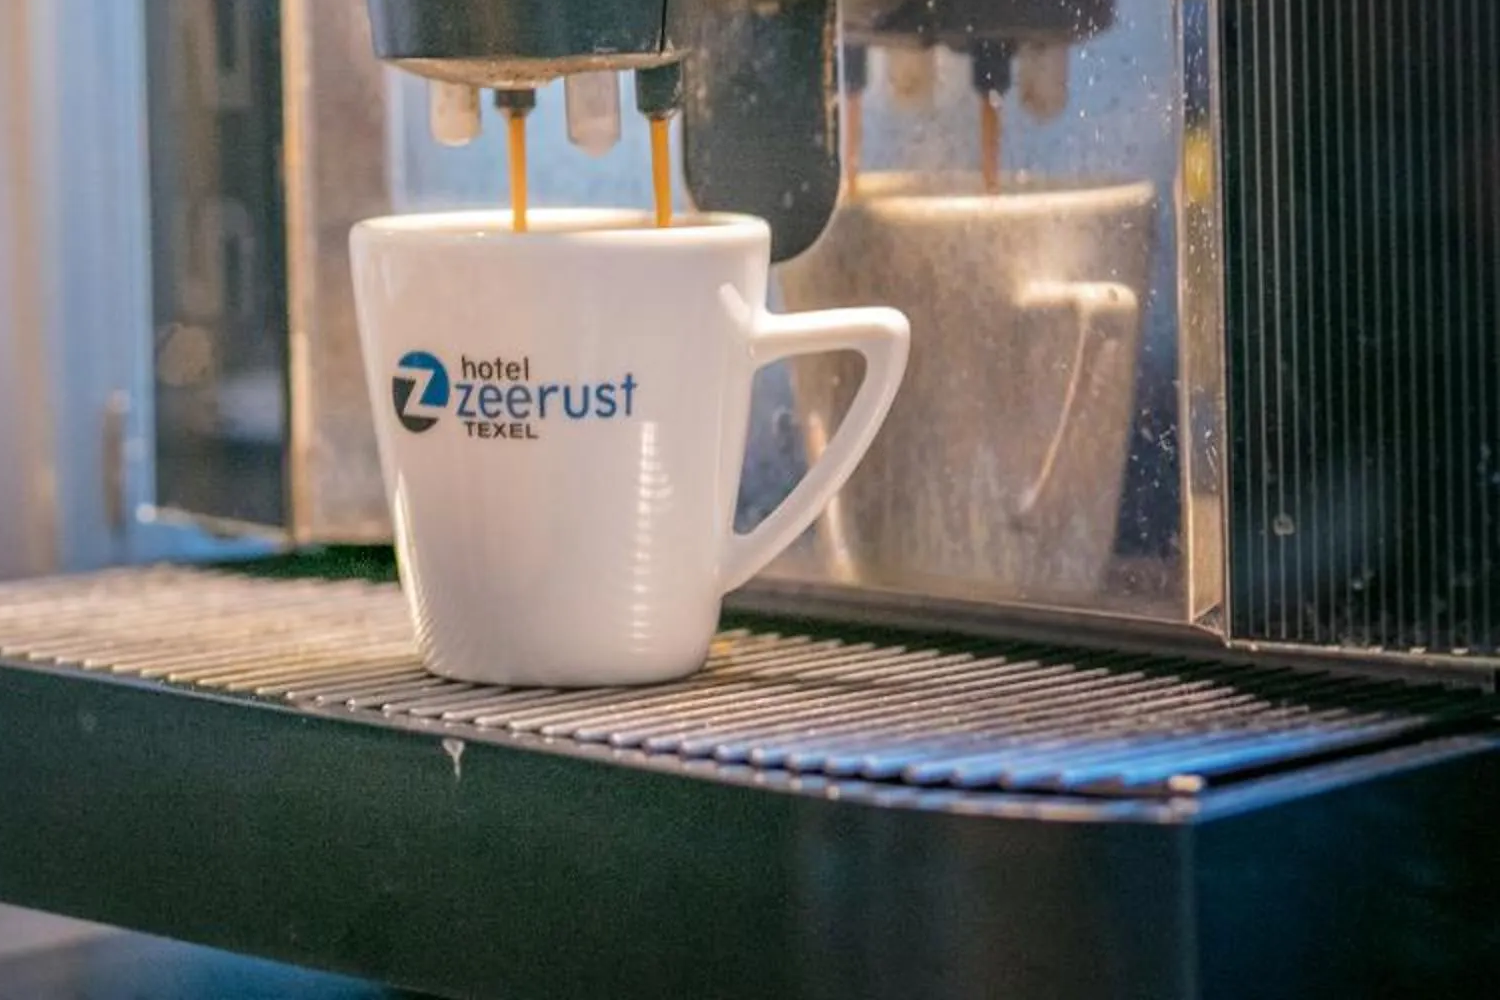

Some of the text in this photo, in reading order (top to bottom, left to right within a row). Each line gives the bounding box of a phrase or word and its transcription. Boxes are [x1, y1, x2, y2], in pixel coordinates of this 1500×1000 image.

[461, 355, 530, 381] hotel
[455, 373, 638, 419] zeerust
[464, 420, 539, 440] TEXEL
